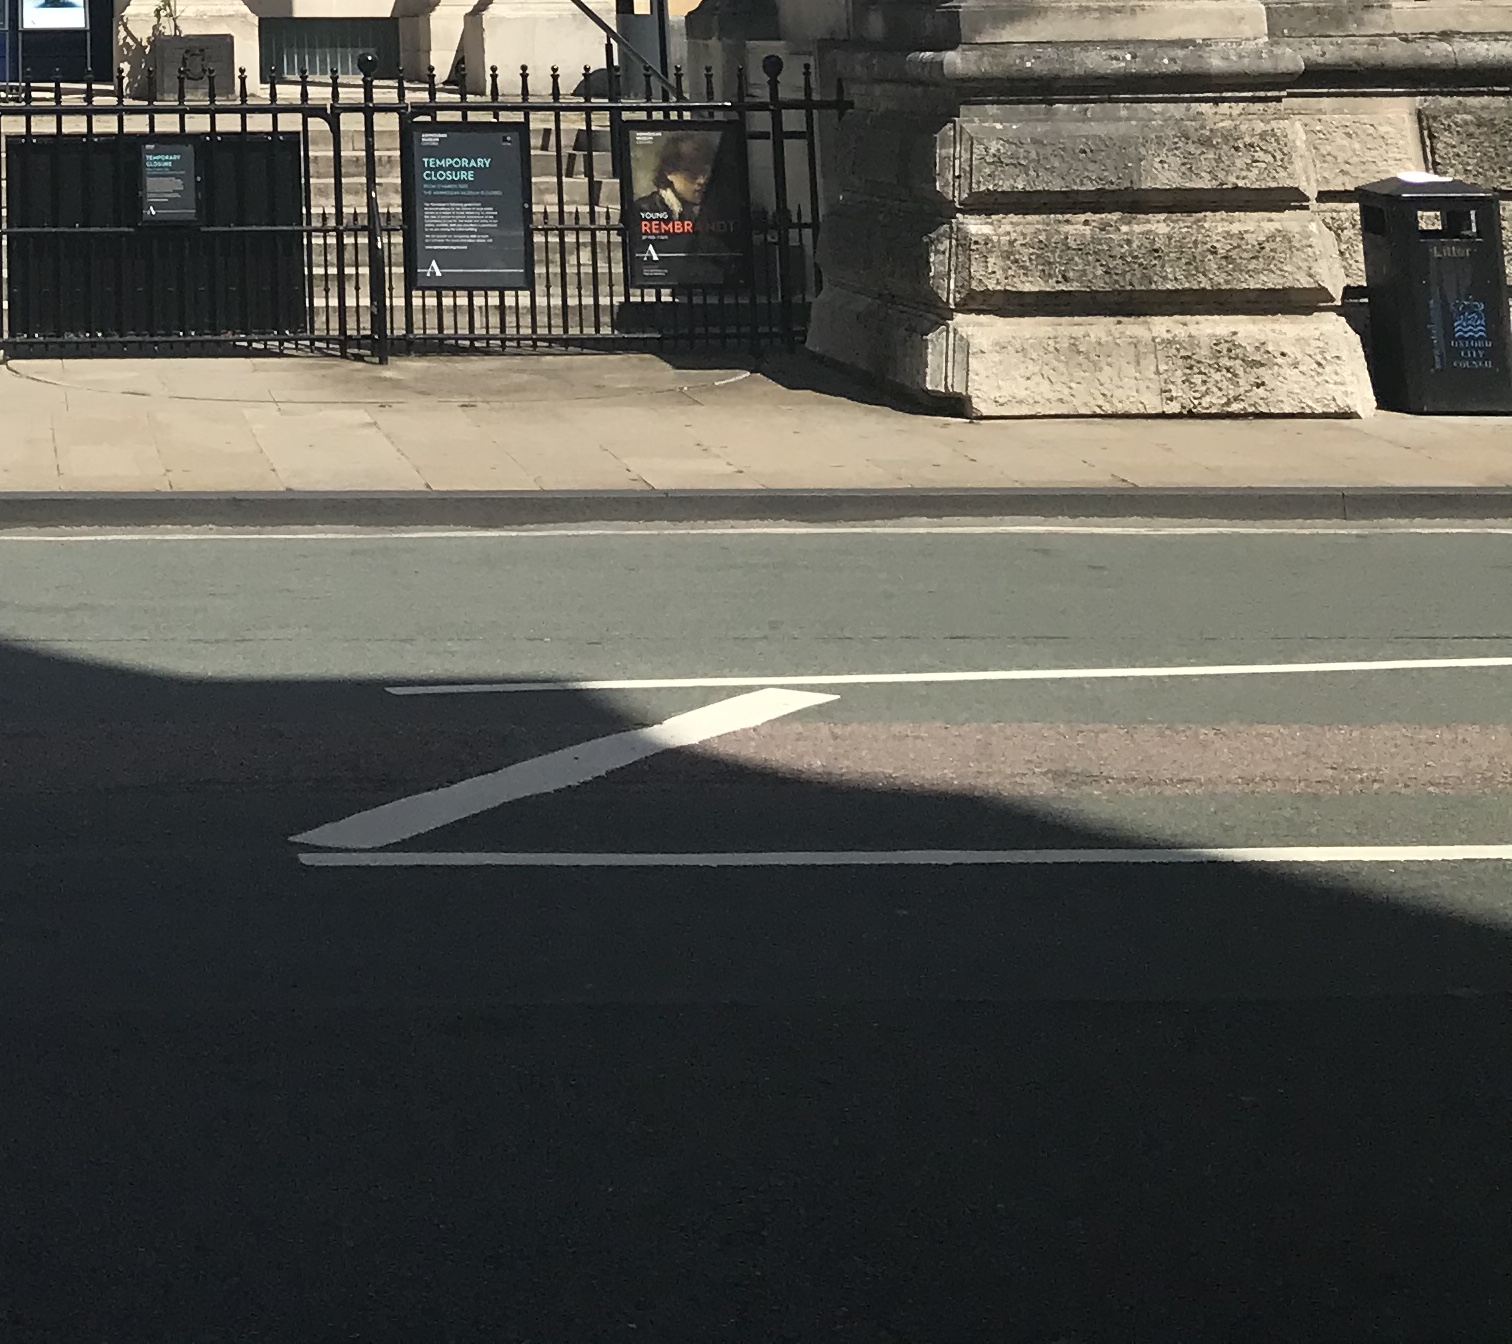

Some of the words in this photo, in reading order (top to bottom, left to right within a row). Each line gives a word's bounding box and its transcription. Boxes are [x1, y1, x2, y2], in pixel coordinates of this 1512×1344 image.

[422, 158, 491, 168] TEMPORARY
[423, 170, 474, 181] CLOSURE
[643, 243, 659, 261] A
[426, 259, 442, 277] A
[1451, 339, 1492, 348] OXFORD
[1461, 349, 1485, 358] CITY
[1453, 360, 1493, 368] COUNCIL
